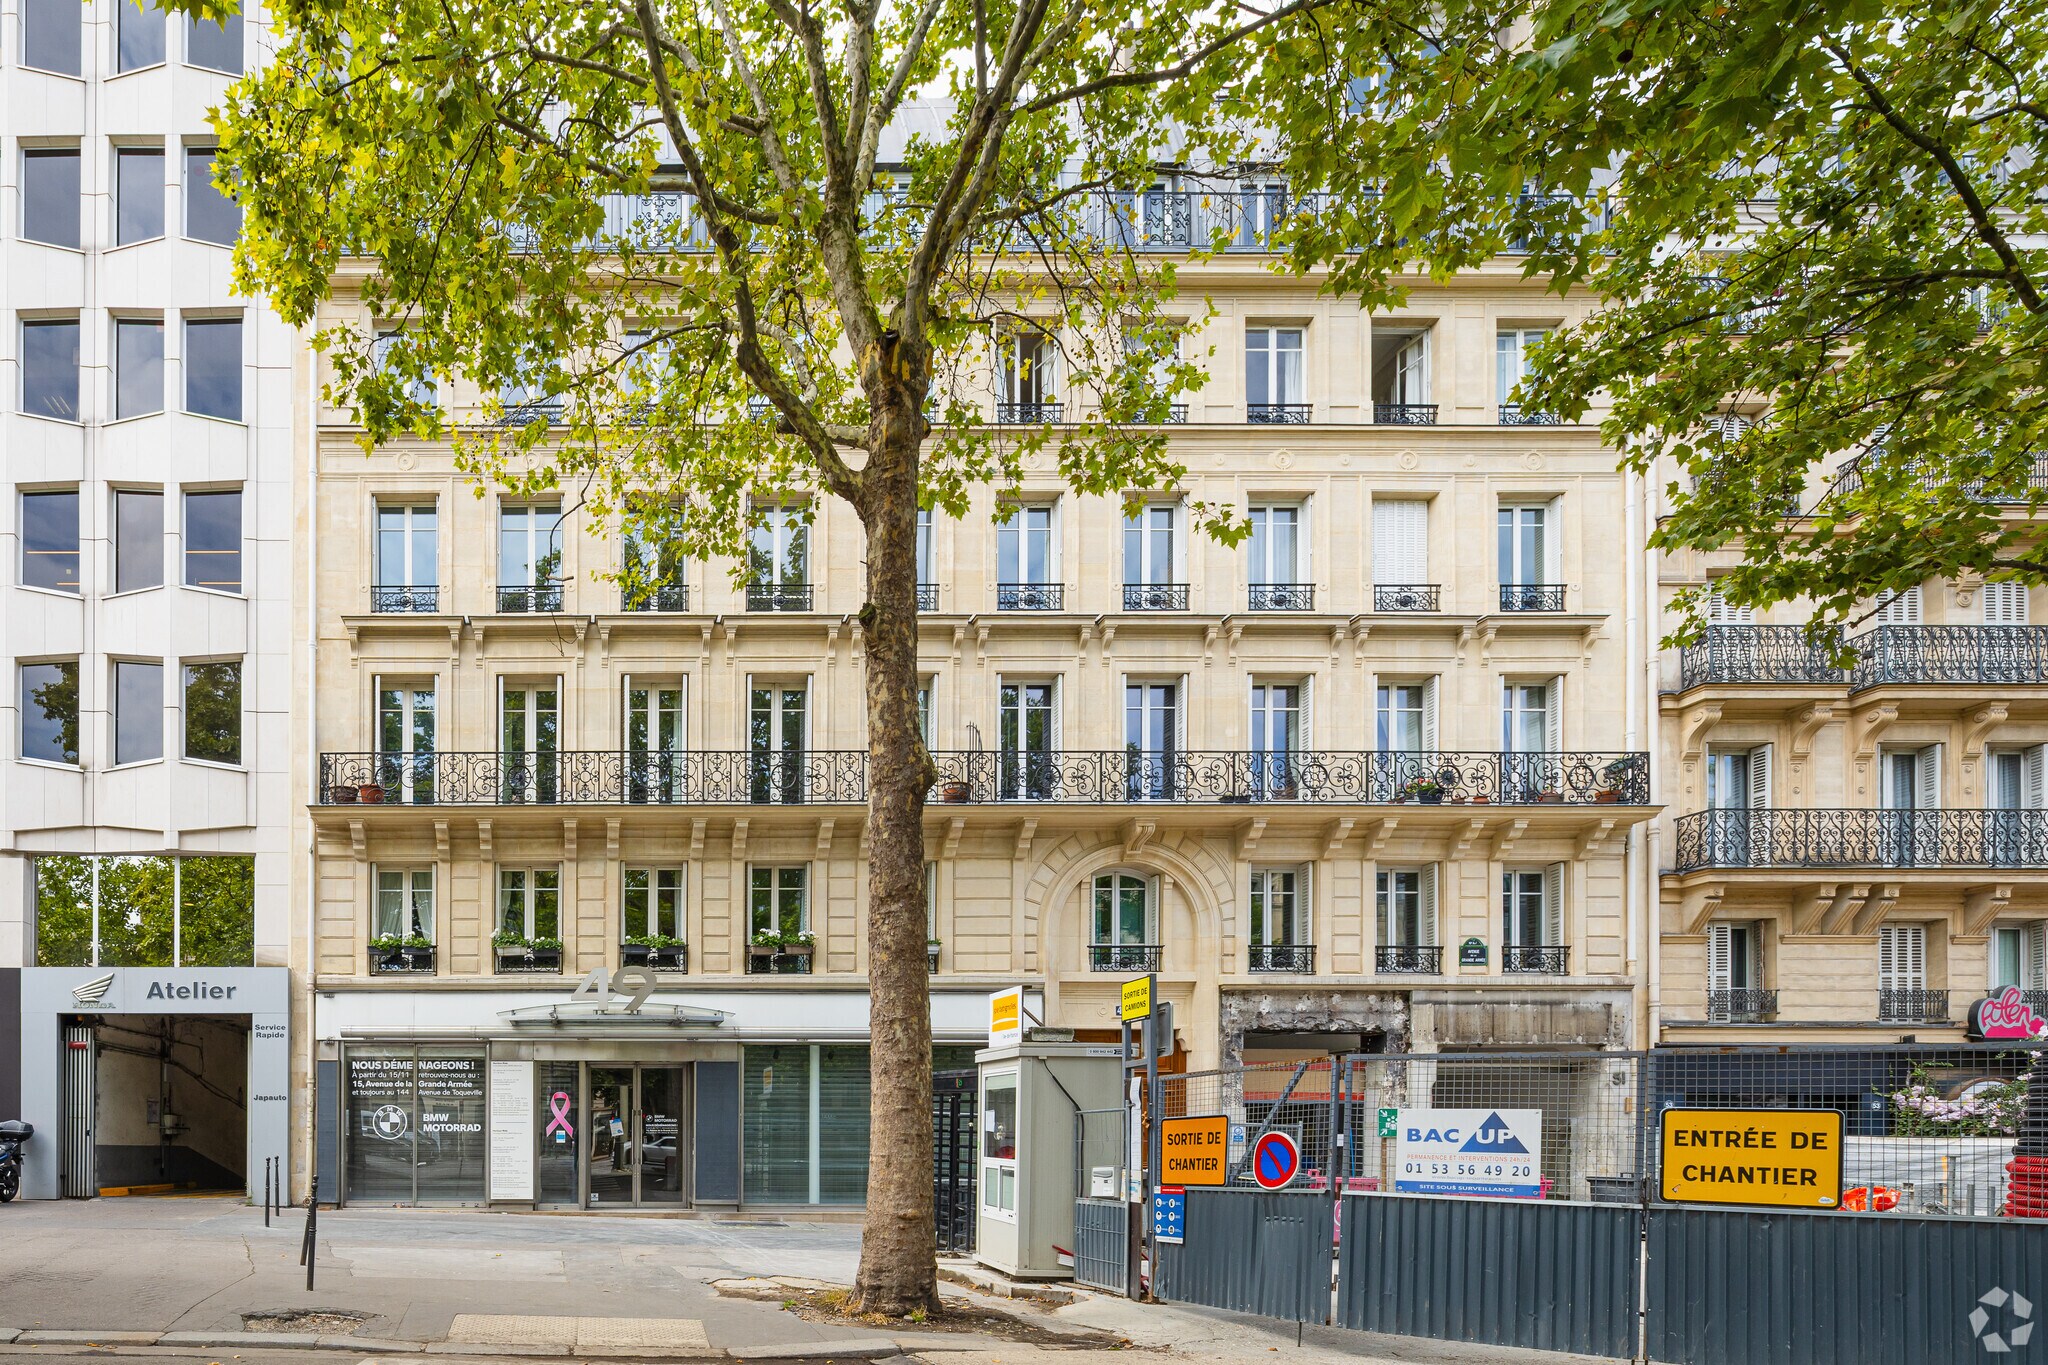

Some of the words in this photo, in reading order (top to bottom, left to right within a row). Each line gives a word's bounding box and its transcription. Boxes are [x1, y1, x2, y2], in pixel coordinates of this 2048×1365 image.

[146, 981, 237, 1000] Atelier
[571, 966, 658, 1011] 49
[1124, 989, 1140, 1000] SORTIE
[1141, 987, 1147, 995] DE
[1125, 1000, 1146, 1011] CAMIONS
[352, 1061, 381, 1070] NOUS
[383, 1059, 413, 1070] DÉME
[419, 1061, 470, 1070] NAGEONS
[472, 1061, 474, 1070] !
[423, 1124, 481, 1132] MOTORRAD
[1167, 1132, 1203, 1146] SORTIE
[1207, 1132, 1221, 1144] DE
[1407, 1128, 1459, 1143] BAC
[1476, 1128, 1515, 1144] UP
[1674, 1128, 1776, 1148] ENTRÉE
[1791, 1132, 1828, 1150] DE
[1169, 1158, 1218, 1171] CHANTIER
[1406, 1163, 1423, 1174] 01
[1432, 1164, 1449, 1174] 53
[1458, 1164, 1475, 1175] 56
[1484, 1165, 1502, 1176] 49
[1512, 1166, 1530, 1177] 20
[1682, 1164, 1817, 1186] CHANTIER
